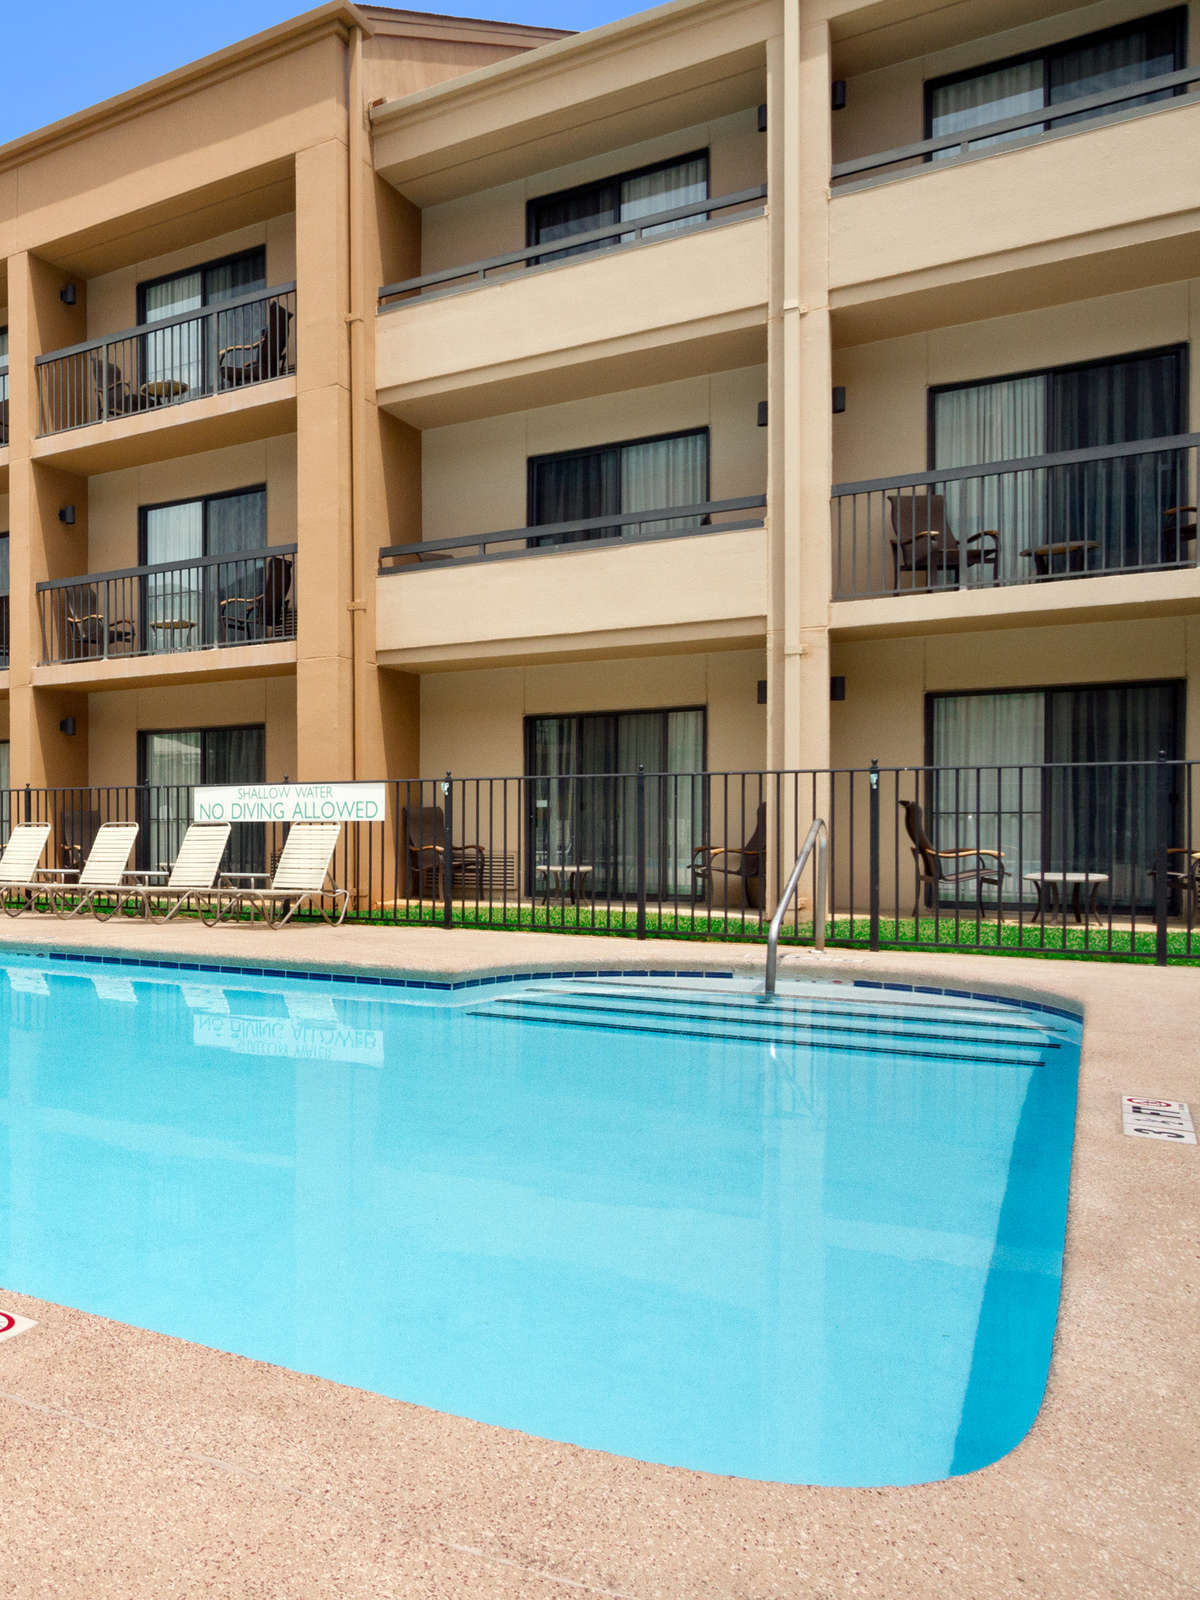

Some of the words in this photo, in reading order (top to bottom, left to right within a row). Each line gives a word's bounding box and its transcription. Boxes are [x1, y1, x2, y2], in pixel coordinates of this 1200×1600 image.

[237, 786, 290, 800] SHALLOW
[295, 786, 333, 798] WATER
[199, 803, 224, 820] NO
[231, 802, 285, 819] DIVING
[292, 800, 378, 819] ALLOWED
